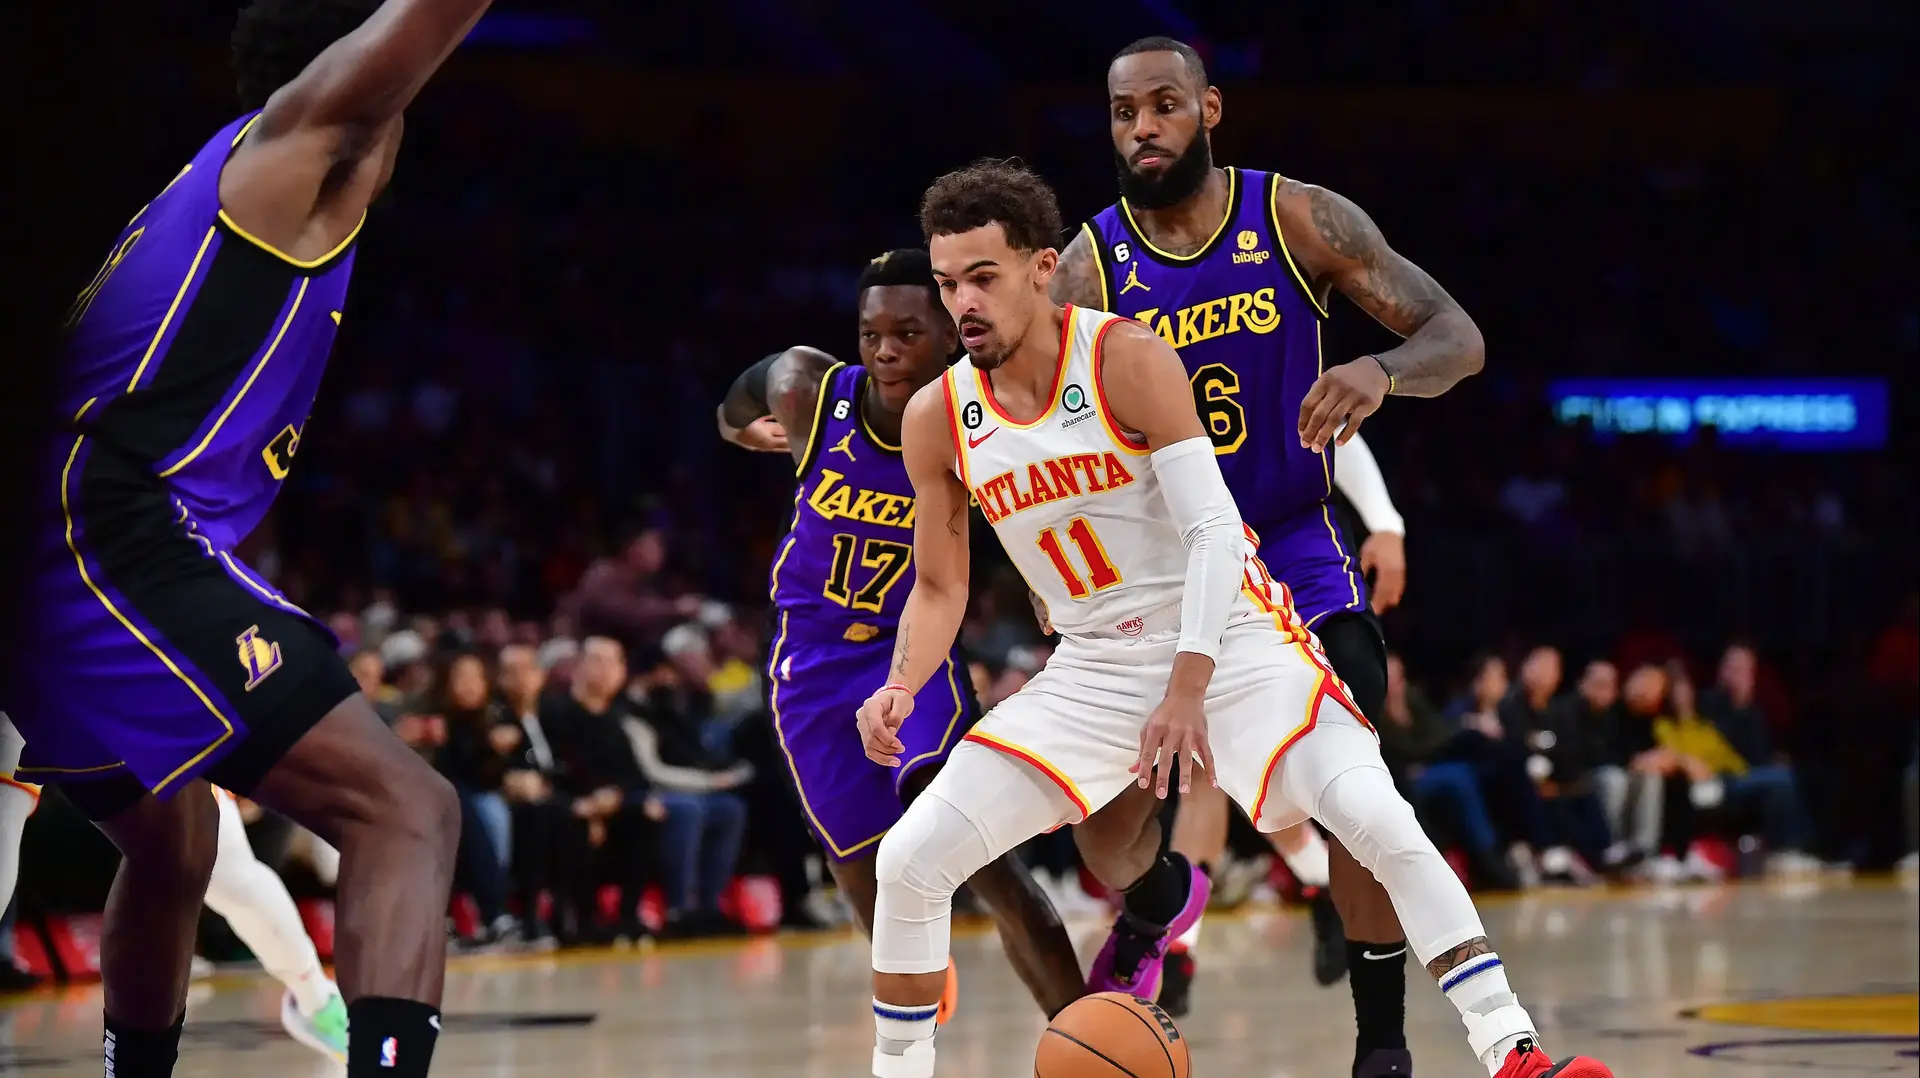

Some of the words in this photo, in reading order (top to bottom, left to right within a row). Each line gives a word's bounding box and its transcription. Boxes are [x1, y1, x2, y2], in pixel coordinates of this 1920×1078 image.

[1114, 243, 1130, 263] 6
[1232, 250, 1270, 265] bibigo
[833, 399, 850, 420] 6
[967, 403, 981, 427] 6
[1061, 410, 1096, 429] sharecare
[1190, 363, 1247, 455] 6
[975, 451, 1136, 524] ATLANTA
[1035, 516, 1123, 599] 11
[823, 533, 913, 614] 17
